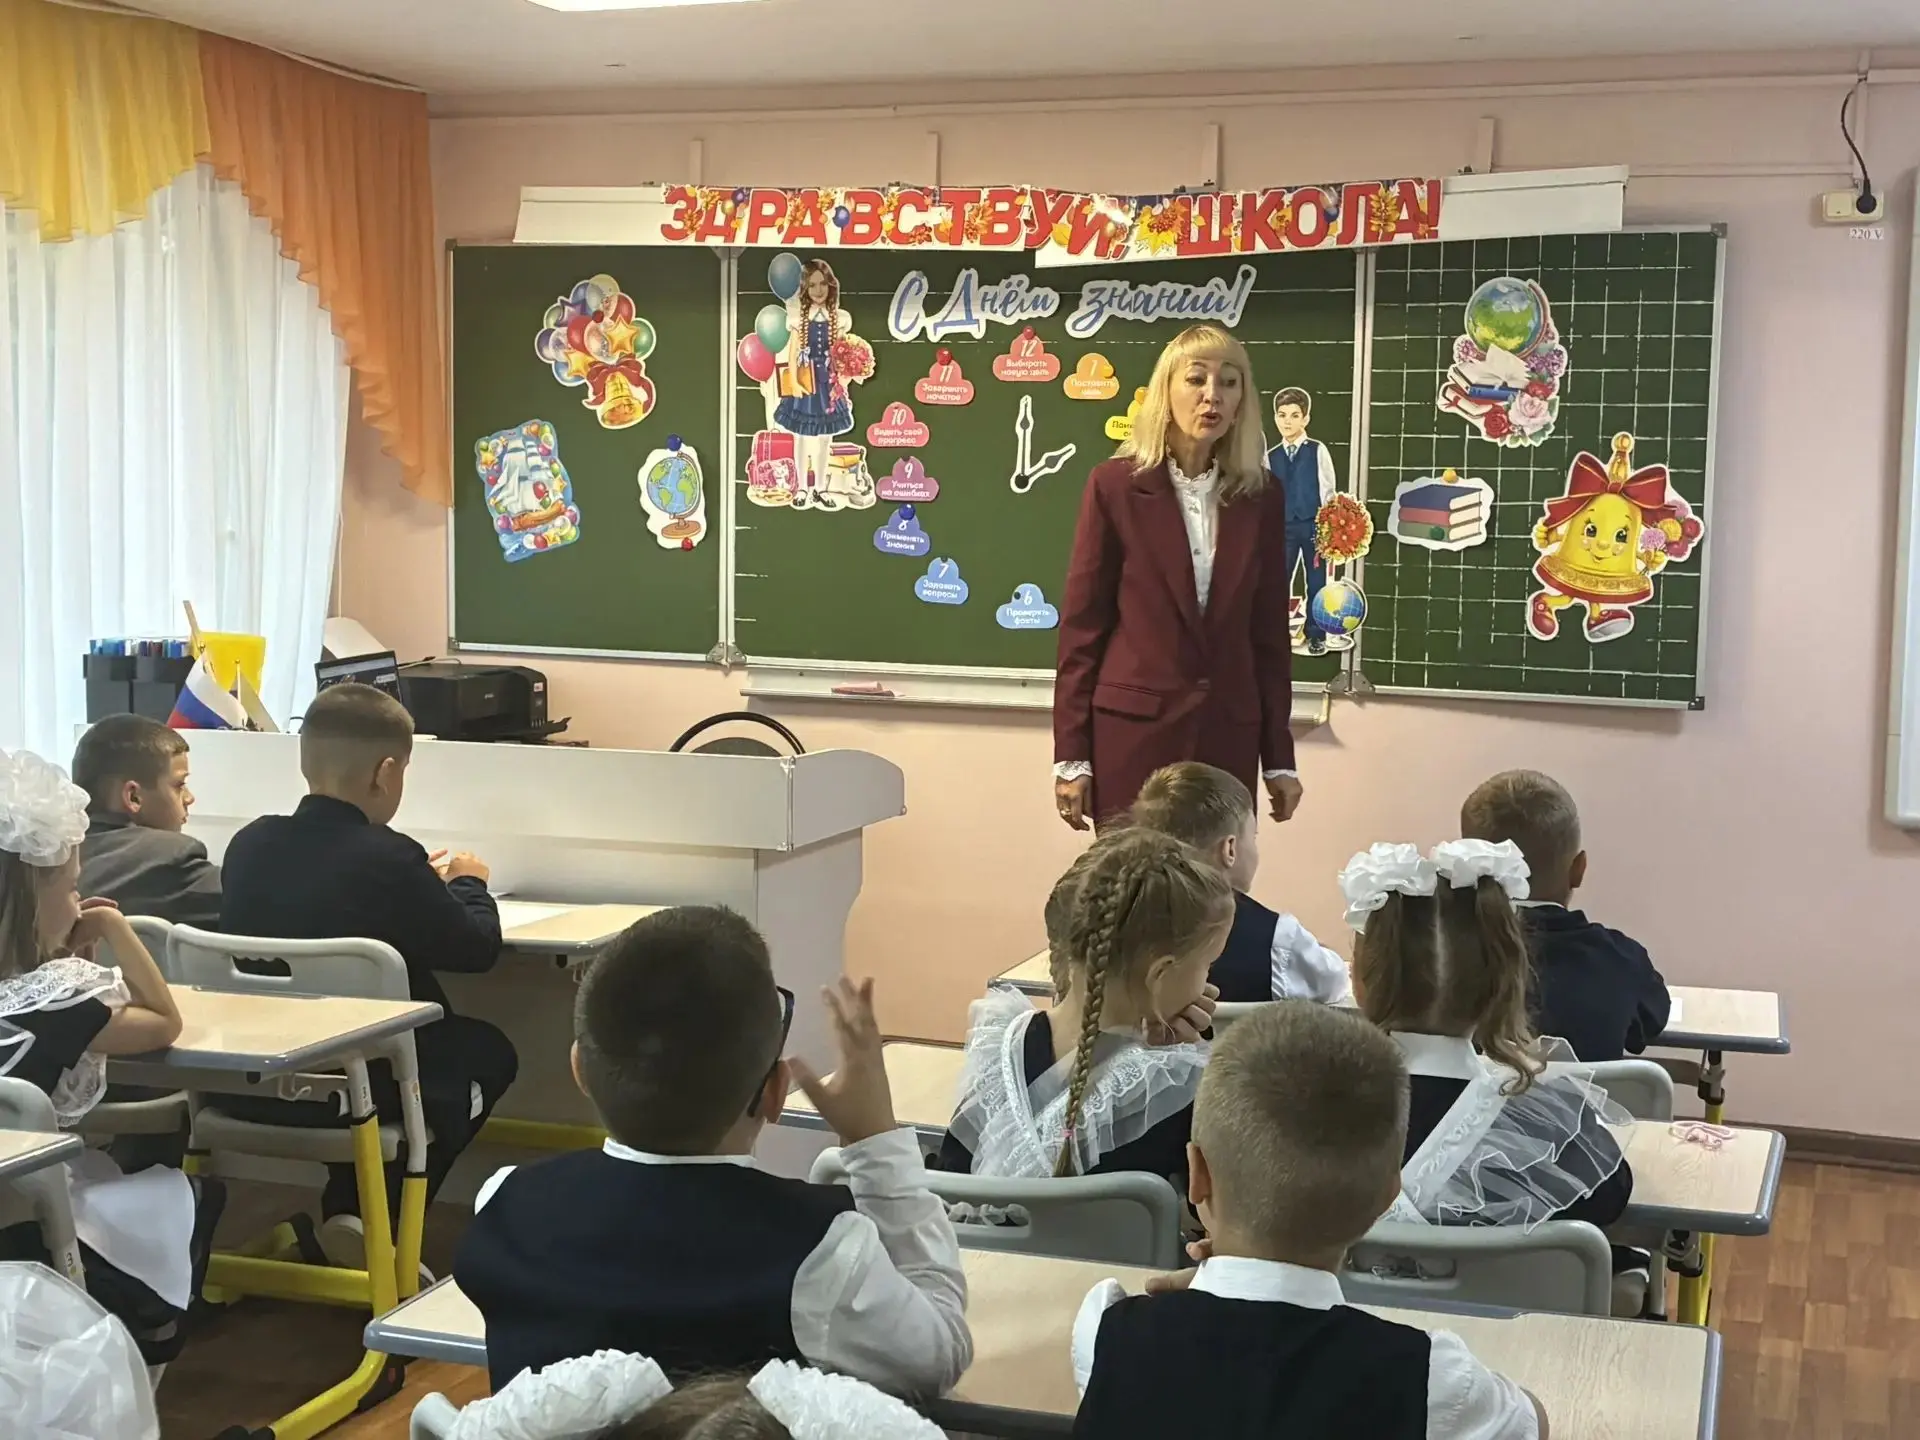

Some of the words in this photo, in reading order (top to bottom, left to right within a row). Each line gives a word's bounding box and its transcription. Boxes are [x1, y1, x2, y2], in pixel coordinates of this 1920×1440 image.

[1176, 178, 1442, 256] ШКОЛА!
[1851, 229, 1871, 239] 220
[1875, 229, 1882, 239] V
[894, 275, 923, 335] С
[932, 272, 1055, 336] Днём
[1072, 272, 1249, 333] знаний!
[1021, 339, 1038, 357] 12
[1005, 359, 1048, 369] Выбирать
[1091, 359, 1098, 376] 1
[939, 365, 954, 382] 11
[1001, 369, 1028, 378] новую
[891, 409, 907, 426] 10
[873, 427, 903, 436] Видеть
[878, 437, 917, 446] прогресс
[904, 462, 914, 479] 9
[891, 480, 924, 489] Учиться
[893, 489, 930, 497] ошибках
[880, 530, 925, 543] Применять
[885, 541, 916, 551] знания
[938, 563, 950, 579] 7
[922, 579, 962, 591] Задавать
[922, 589, 958, 599] вопросы
[1023, 590, 1033, 606] 6
[1014, 617, 1041, 626] факты
